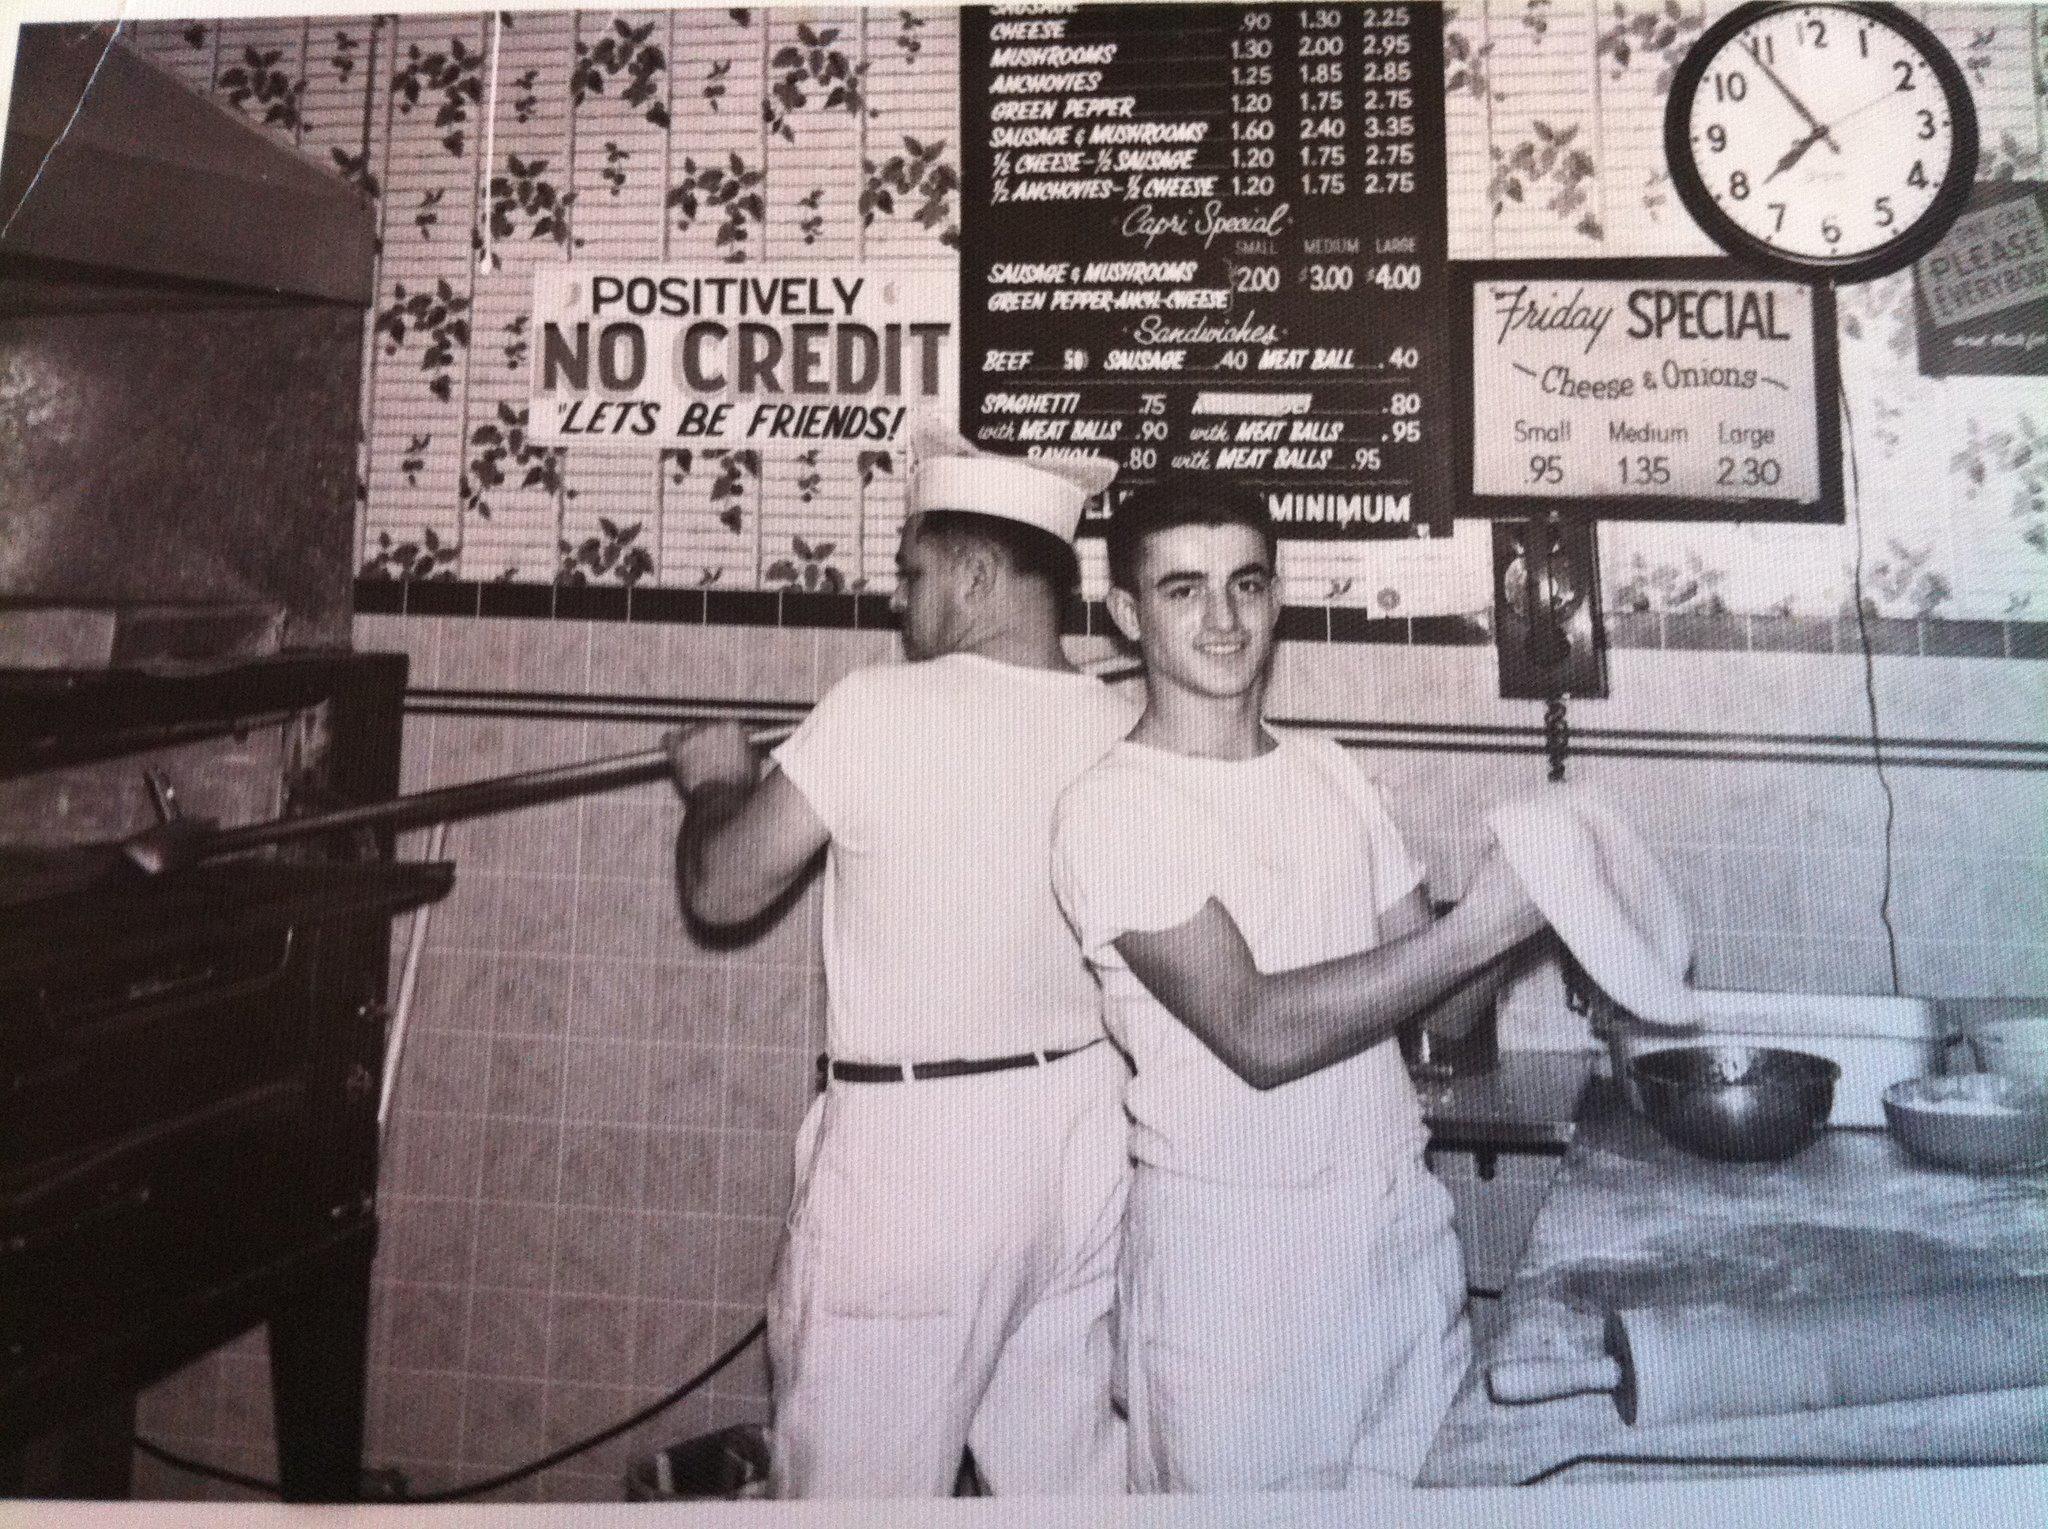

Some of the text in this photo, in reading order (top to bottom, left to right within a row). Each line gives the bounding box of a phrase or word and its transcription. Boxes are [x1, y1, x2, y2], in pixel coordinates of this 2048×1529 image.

[990, 7, 1410, 41] CHEESE .90 1.30 2.25
[1798, 20, 1828, 48] 12
[990, 33, 1411, 68] MUSHROOMS 1.30 2.00 2.95
[1752, 35, 1774, 65] 11
[1858, 28, 1869, 58] 1
[989, 60, 1412, 93] ANCHOVIES 1.25 1.85 2.85
[1714, 72, 1747, 102] 10
[1893, 61, 1915, 91] 2
[990, 88, 1413, 122] GREEN PEPPER 1.20 1.75 2.75
[989, 125, 1073, 148] SAUSAGE
[1089, 121, 1208, 145] MUSHROOMS
[1232, 119, 1275, 140] 1.60
[1300, 117, 1345, 139] 2.40
[1364, 115, 1415, 138] 3.35
[1706, 125, 1727, 152] 9
[1917, 109, 1936, 140] 3
[1114, 149, 1198, 172] SAUSAGE
[1232, 147, 1275, 168] 1.20
[1301, 146, 1345, 166] 1.75
[1365, 143, 1414, 165] 2.75
[1143, 175, 1219, 199] CHEESE
[1233, 175, 1275, 196] 1.20
[1302, 173, 1345, 194] 1.75
[1365, 172, 1414, 194] 2.75
[1729, 171, 1750, 200] 8
[1906, 160, 1929, 189] 4
[1122, 200, 1289, 249] Capri Special
[1767, 203, 1787, 232] 7
[1874, 196, 1895, 227] 5
[1304, 237, 1359, 254] MEDIUM
[1376, 235, 1415, 253] LARGE
[1821, 217, 1842, 243] 6
[1929, 228, 2043, 277] PLEASE
[987, 262, 1070, 284] SAUSAGE
[1083, 261, 1198, 285] MUSHROOMS
[1933, 258, 2047, 316] EVERYBOD
[592, 276, 864, 316] POSITIVELY
[988, 291, 1047, 312] GREEN
[1134, 310, 1278, 345] Sandwiches
[1488, 283, 1791, 353] Friday SPECIAL
[543, 320, 951, 396] NO CREDIT
[982, 350, 1034, 372] BEEF
[1103, 350, 1187, 371] SAUSAGE
[1258, 349, 1309, 370] MEAT
[1310, 349, 1354, 370] BALL
[1379, 347, 1419, 370] .40
[1541, 359, 1758, 399] Cheese & Onions
[981, 393, 1166, 415] SPAGHETTI .75
[1383, 393, 1421, 415] .80
[677, 402, 734, 437] BE
[746, 404, 906, 441] FRIENDS!
[978, 420, 1168, 442] with MEAT BALLS .90
[1190, 421, 1421, 442] with MEAT BALLS .95
[1514, 420, 1776, 450] Small Medium Large
[1123, 448, 1157, 470] .80
[1171, 451, 1211, 470] with
[1216, 448, 1272, 469] MEAT
[1273, 448, 1332, 469] BALLS
[1351, 448, 1381, 470] .95
[1524, 456, 1564, 485] .95
[1269, 493, 1411, 525] MINIMUM
